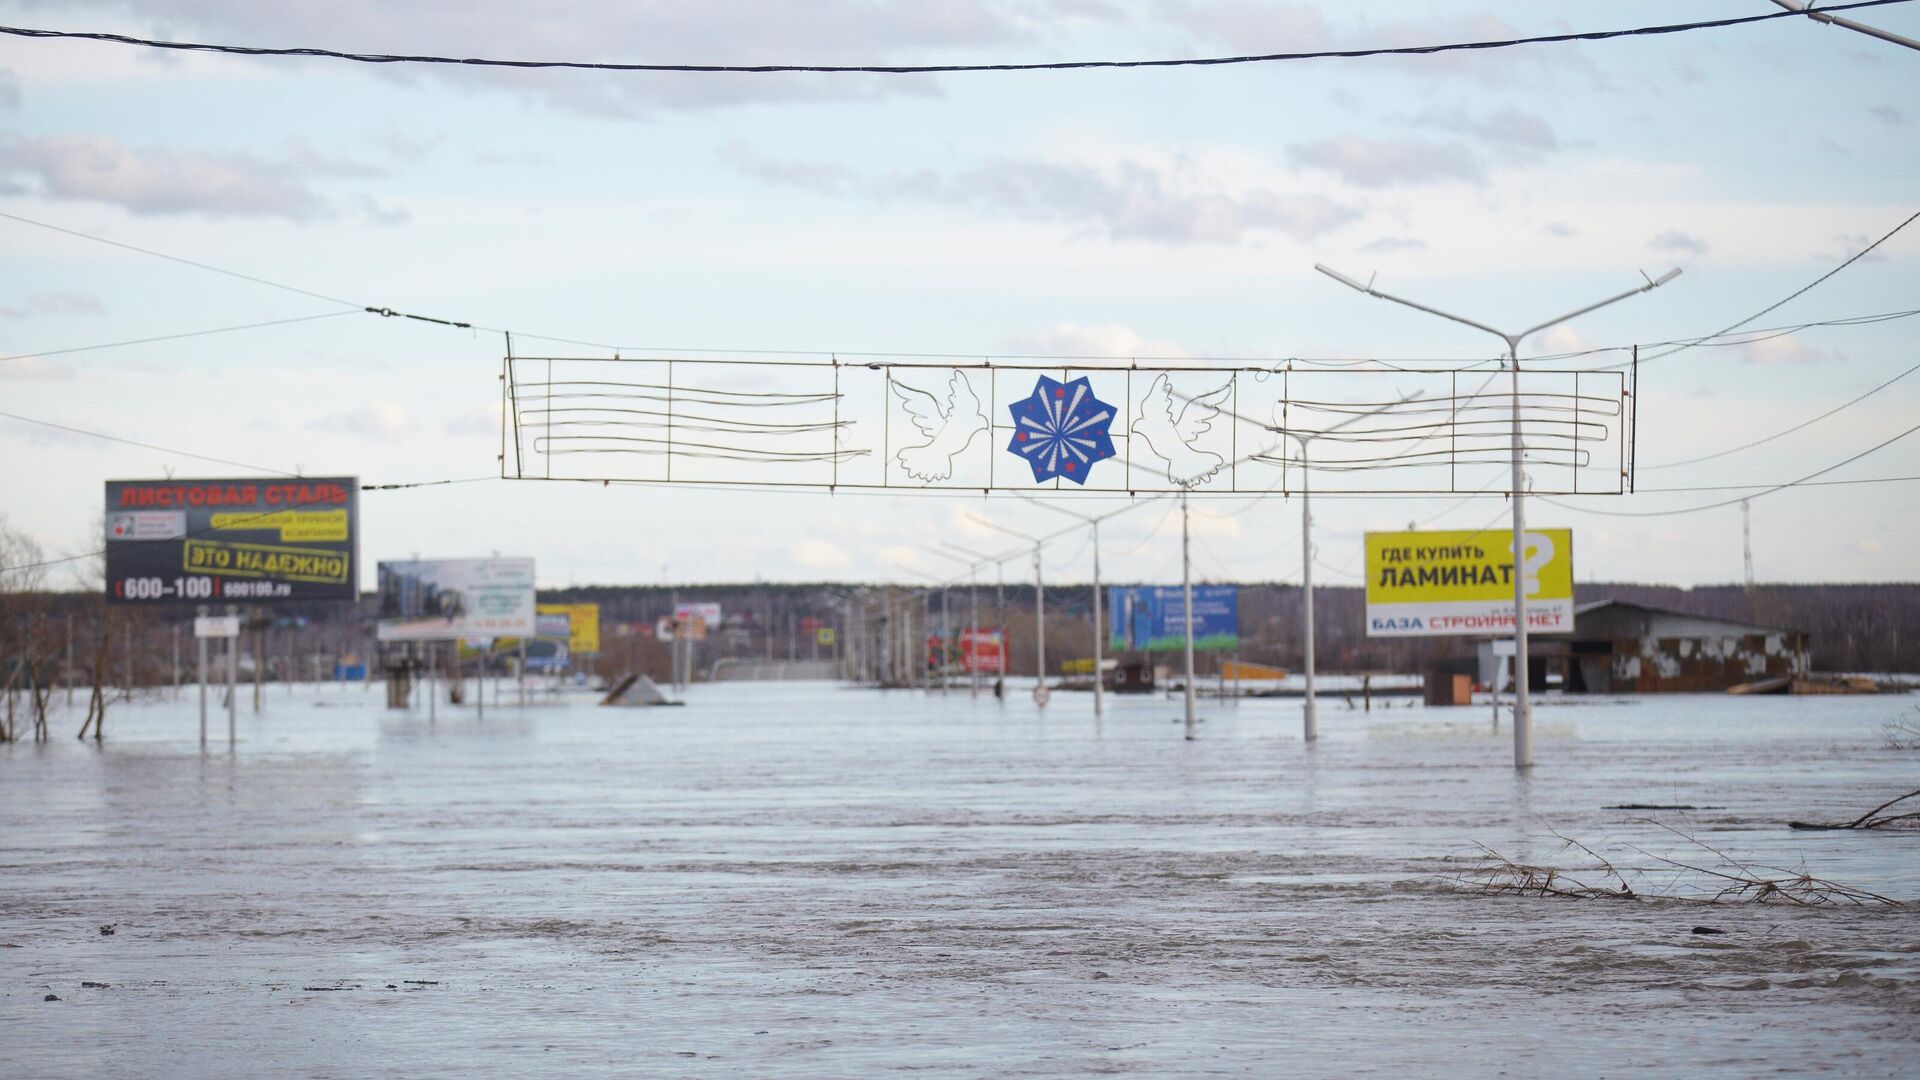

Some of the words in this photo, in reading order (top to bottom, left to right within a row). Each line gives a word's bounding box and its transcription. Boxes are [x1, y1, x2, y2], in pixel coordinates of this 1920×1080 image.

[120, 486, 257, 506] ЛИСТОВАЯ
[265, 484, 347, 506] СТАЛЬ
[191, 546, 230, 567] ЭТО
[236, 552, 341, 576] НАДЕЖНО
[1381, 548, 1411, 563] ГДЕ
[1416, 547, 1485, 561] КУПИТЬ
[1380, 565, 1514, 587] ЛАМИНАТ
[125, 577, 212, 599] 600-100
[223, 582, 291, 598] 600100.ru
[1372, 616, 1423, 630] БАЗА
[1429, 613, 1563, 629] СТРОЙМАКЕТ
